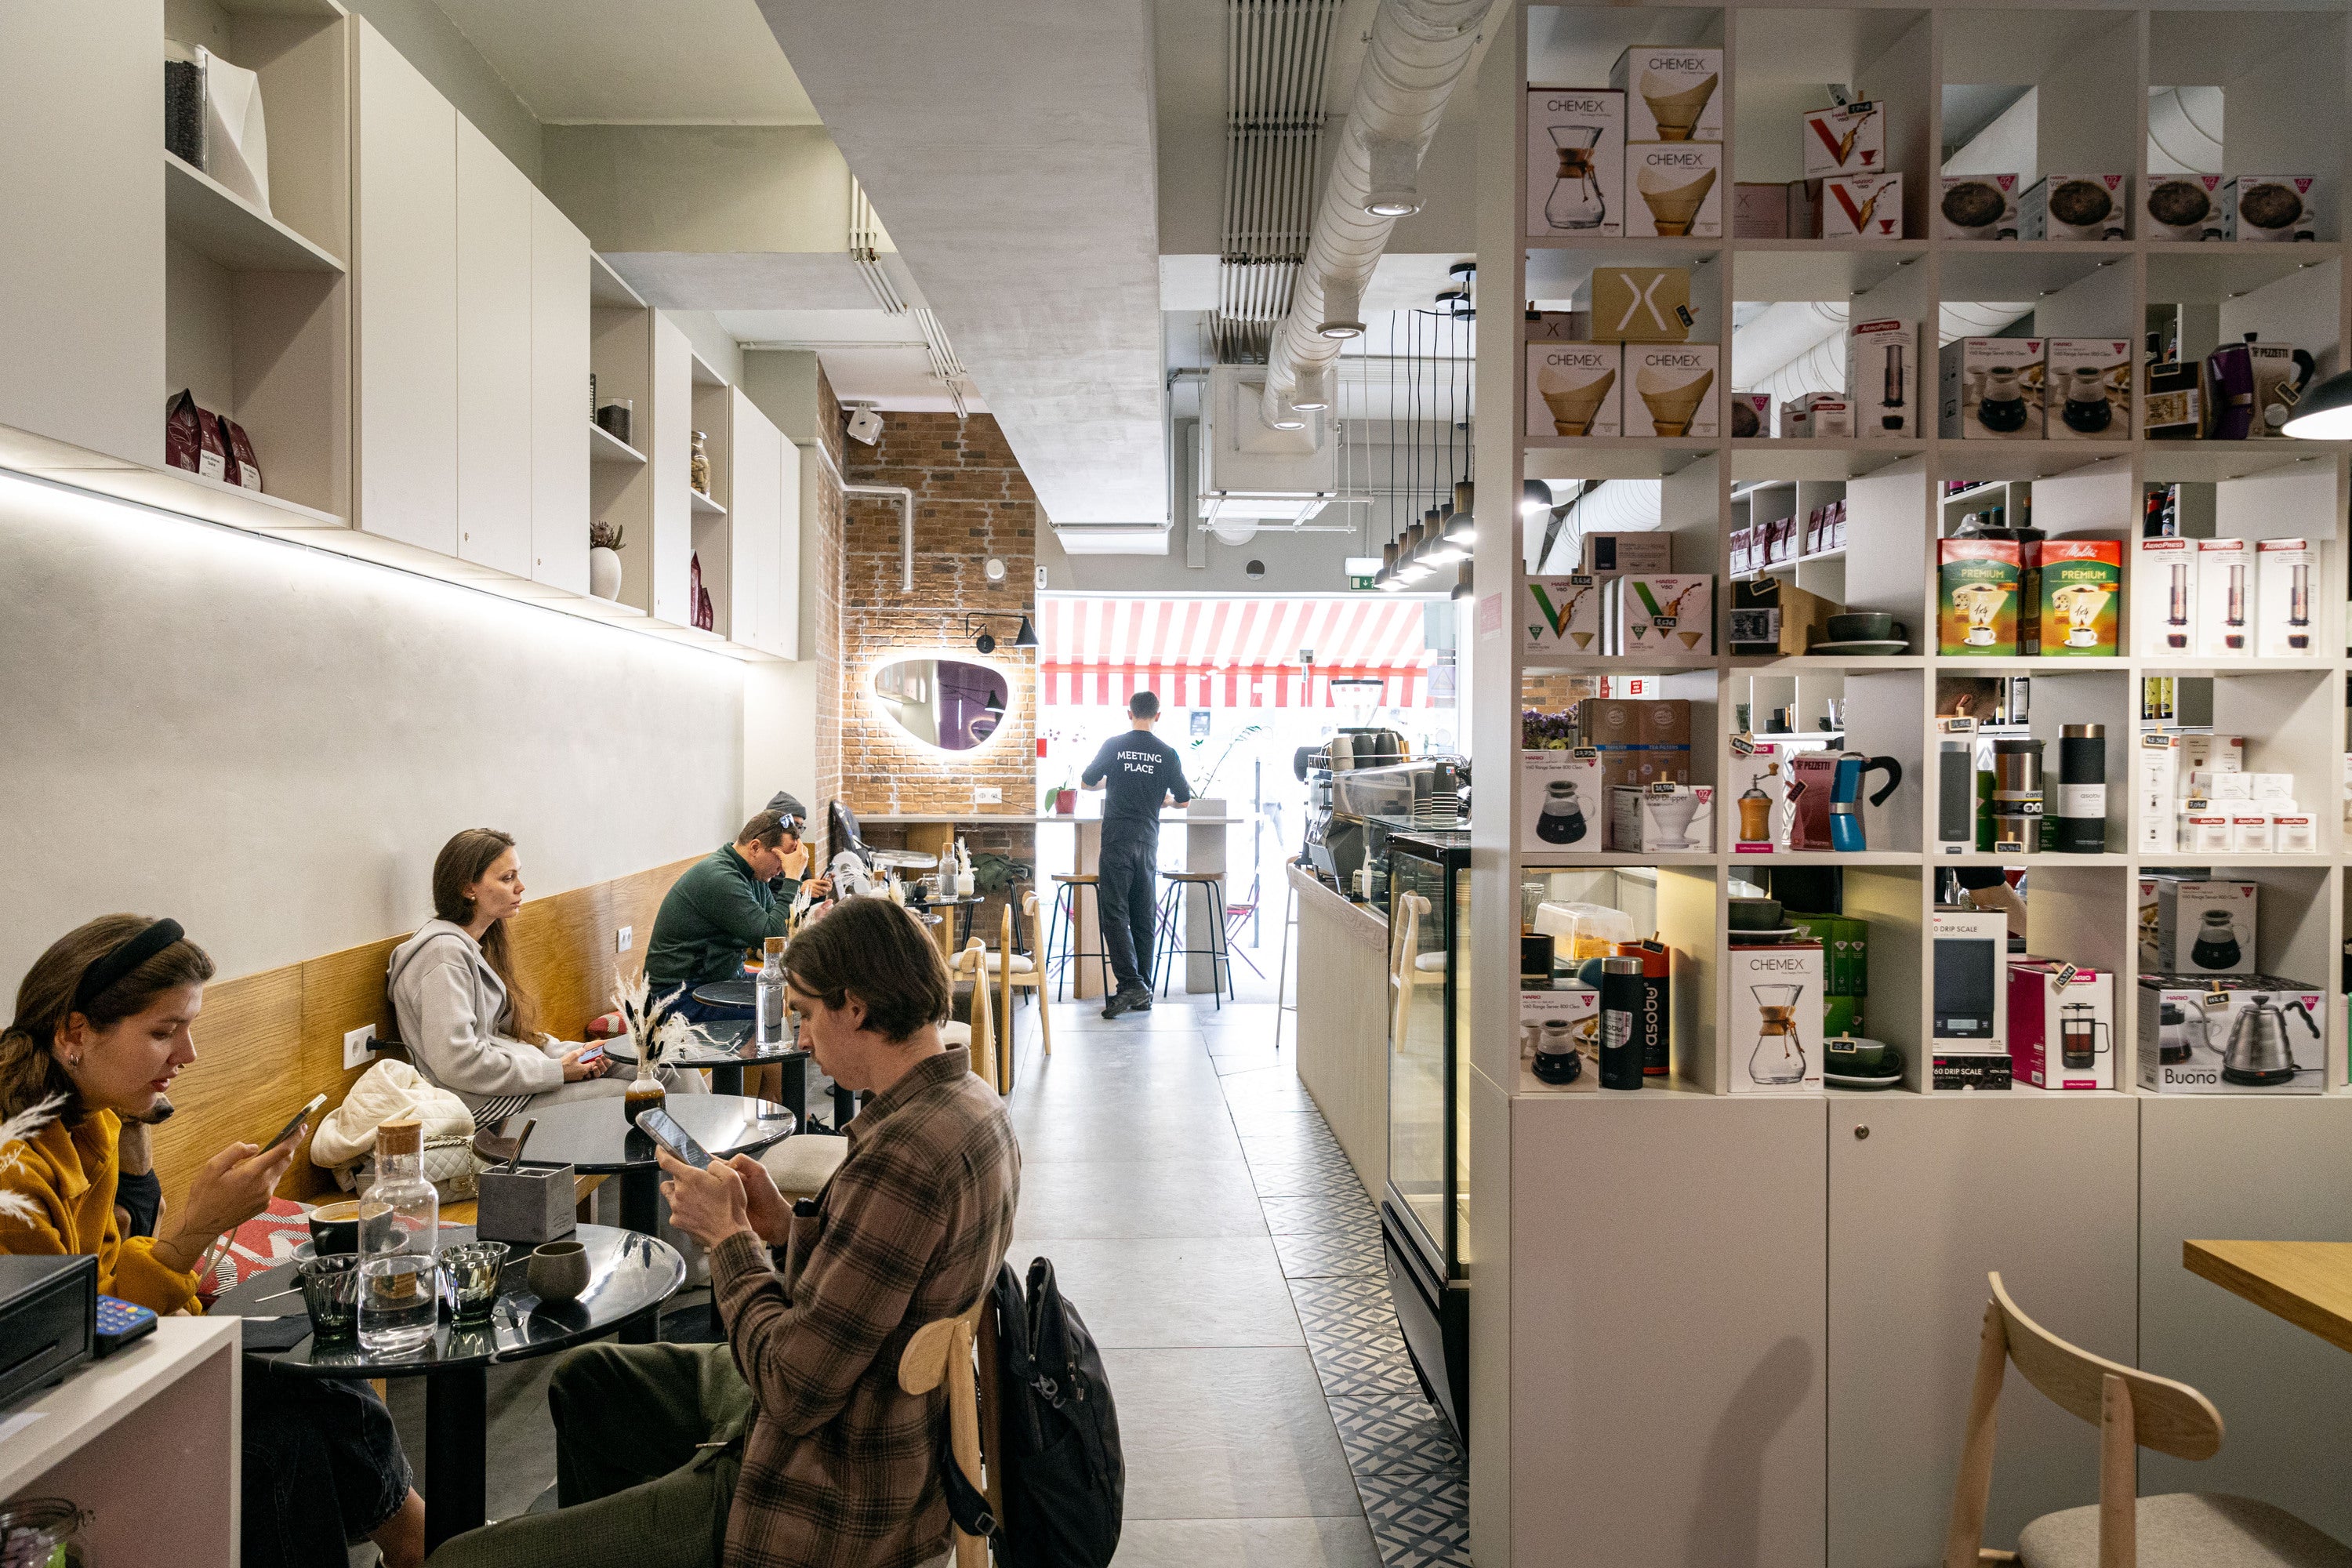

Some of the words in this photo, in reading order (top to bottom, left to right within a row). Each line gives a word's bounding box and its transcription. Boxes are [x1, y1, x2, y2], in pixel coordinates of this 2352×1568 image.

[1649, 58, 1704, 71] CHEMEX
[1547, 100, 1605, 112] CHEMEX
[1646, 154, 1704, 166] CHEMEX
[1999, 176, 2011, 185] 02
[2106, 176, 2118, 184] 02
[2204, 176, 2216, 185] 02
[2296, 179, 2308, 187] 02
[2260, 348, 2289, 358] PEZZETTI
[1547, 354, 1602, 367] CHEMEX
[1645, 354, 1701, 367] CHEMEX
[1755, 397, 1766, 406] 02
[1961, 568, 2004, 579] PREMIUM
[2061, 570, 2107, 580] PREMIUM
[1117, 751, 1162, 763] MEETING
[1124, 763, 1154, 774] PLACE
[1804, 761, 1831, 771] PEZZETTI
[1750, 959, 1805, 971] CHEMEX
[1643, 987, 1658, 1046] asobu
[2165, 1069, 2217, 1084] Buono
